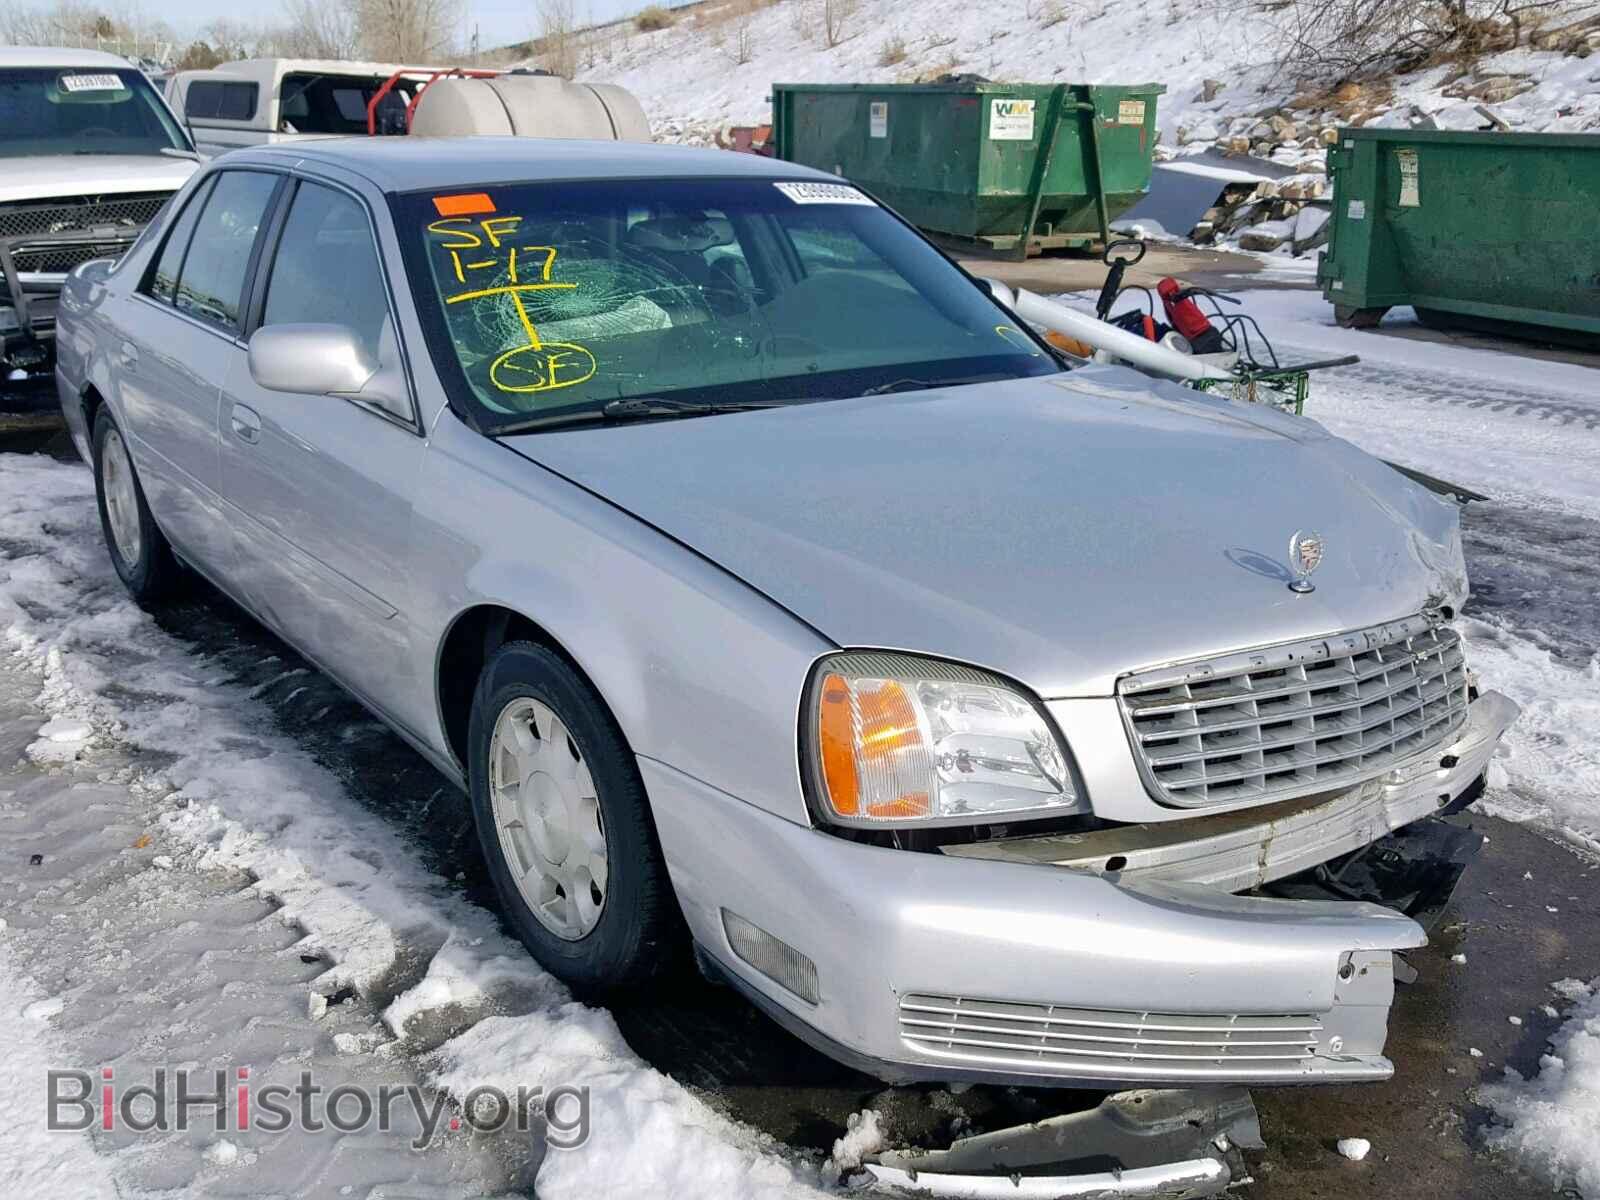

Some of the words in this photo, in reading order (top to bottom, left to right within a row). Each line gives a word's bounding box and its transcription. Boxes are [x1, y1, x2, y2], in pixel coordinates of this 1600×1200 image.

[995, 102, 1030, 118] WM
[427, 216, 524, 247] SF
[451, 247, 557, 283] 1-17
